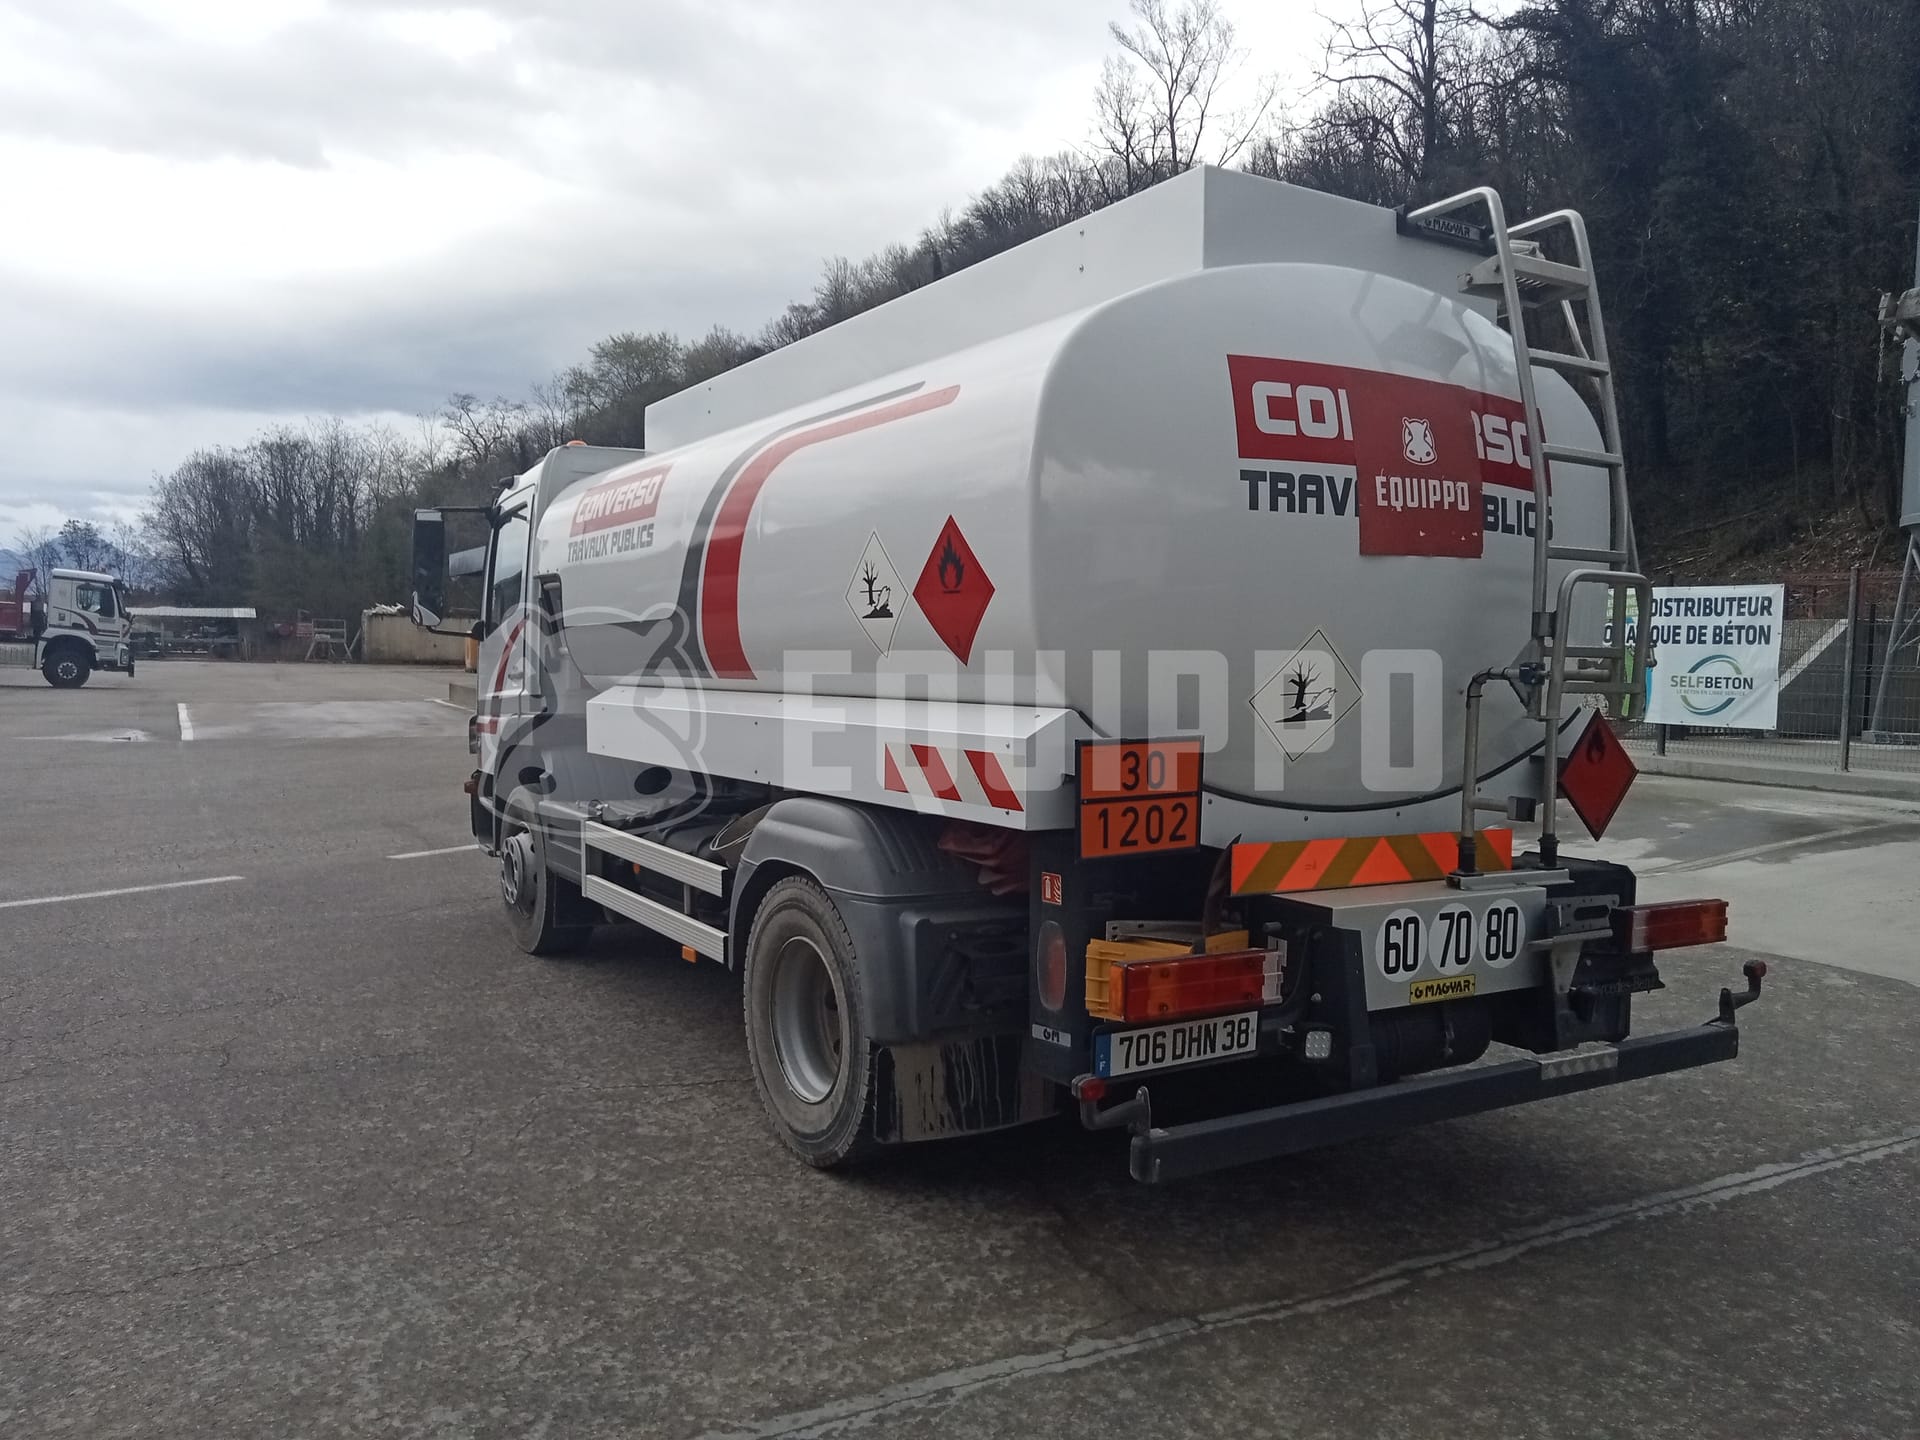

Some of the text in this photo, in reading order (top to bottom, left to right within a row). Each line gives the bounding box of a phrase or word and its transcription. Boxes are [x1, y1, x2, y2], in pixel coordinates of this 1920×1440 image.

[575, 474, 663, 523] CONVERSO
[1240, 469, 1360, 518] TRAV
[567, 523, 654, 563] TRAVAUX PUBLICS
[1686, 624, 1706, 645] DE
[1712, 620, 1771, 646] BÉTON
[1670, 675, 1753, 690] SELFBETON
[1122, 750, 1166, 791] 30
[1098, 802, 1189, 849] 1202
[1384, 906, 1519, 975] 60 70 80
[1425, 980, 1471, 998] MAGYAR
[1099, 1017, 1250, 1072] F 706 DHN 38
